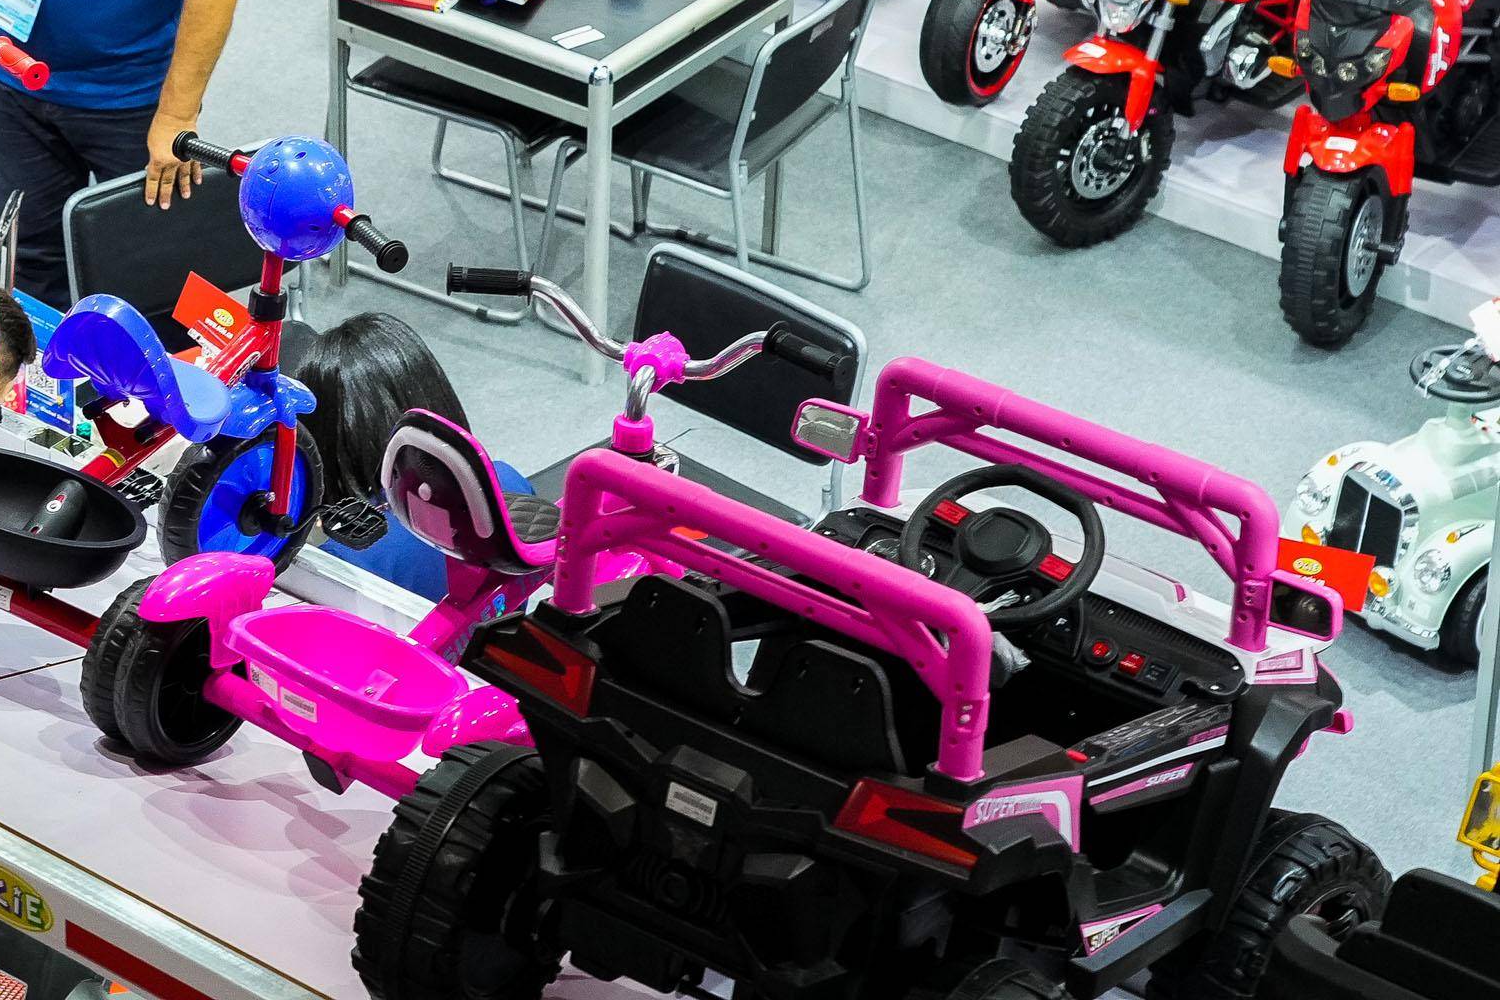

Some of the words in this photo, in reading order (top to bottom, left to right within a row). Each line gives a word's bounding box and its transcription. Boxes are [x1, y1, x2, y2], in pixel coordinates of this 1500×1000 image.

[1145, 768, 1189, 788] SUPER
[974, 797, 1016, 825] SUPER
[1090, 925, 1121, 950] SUPER
